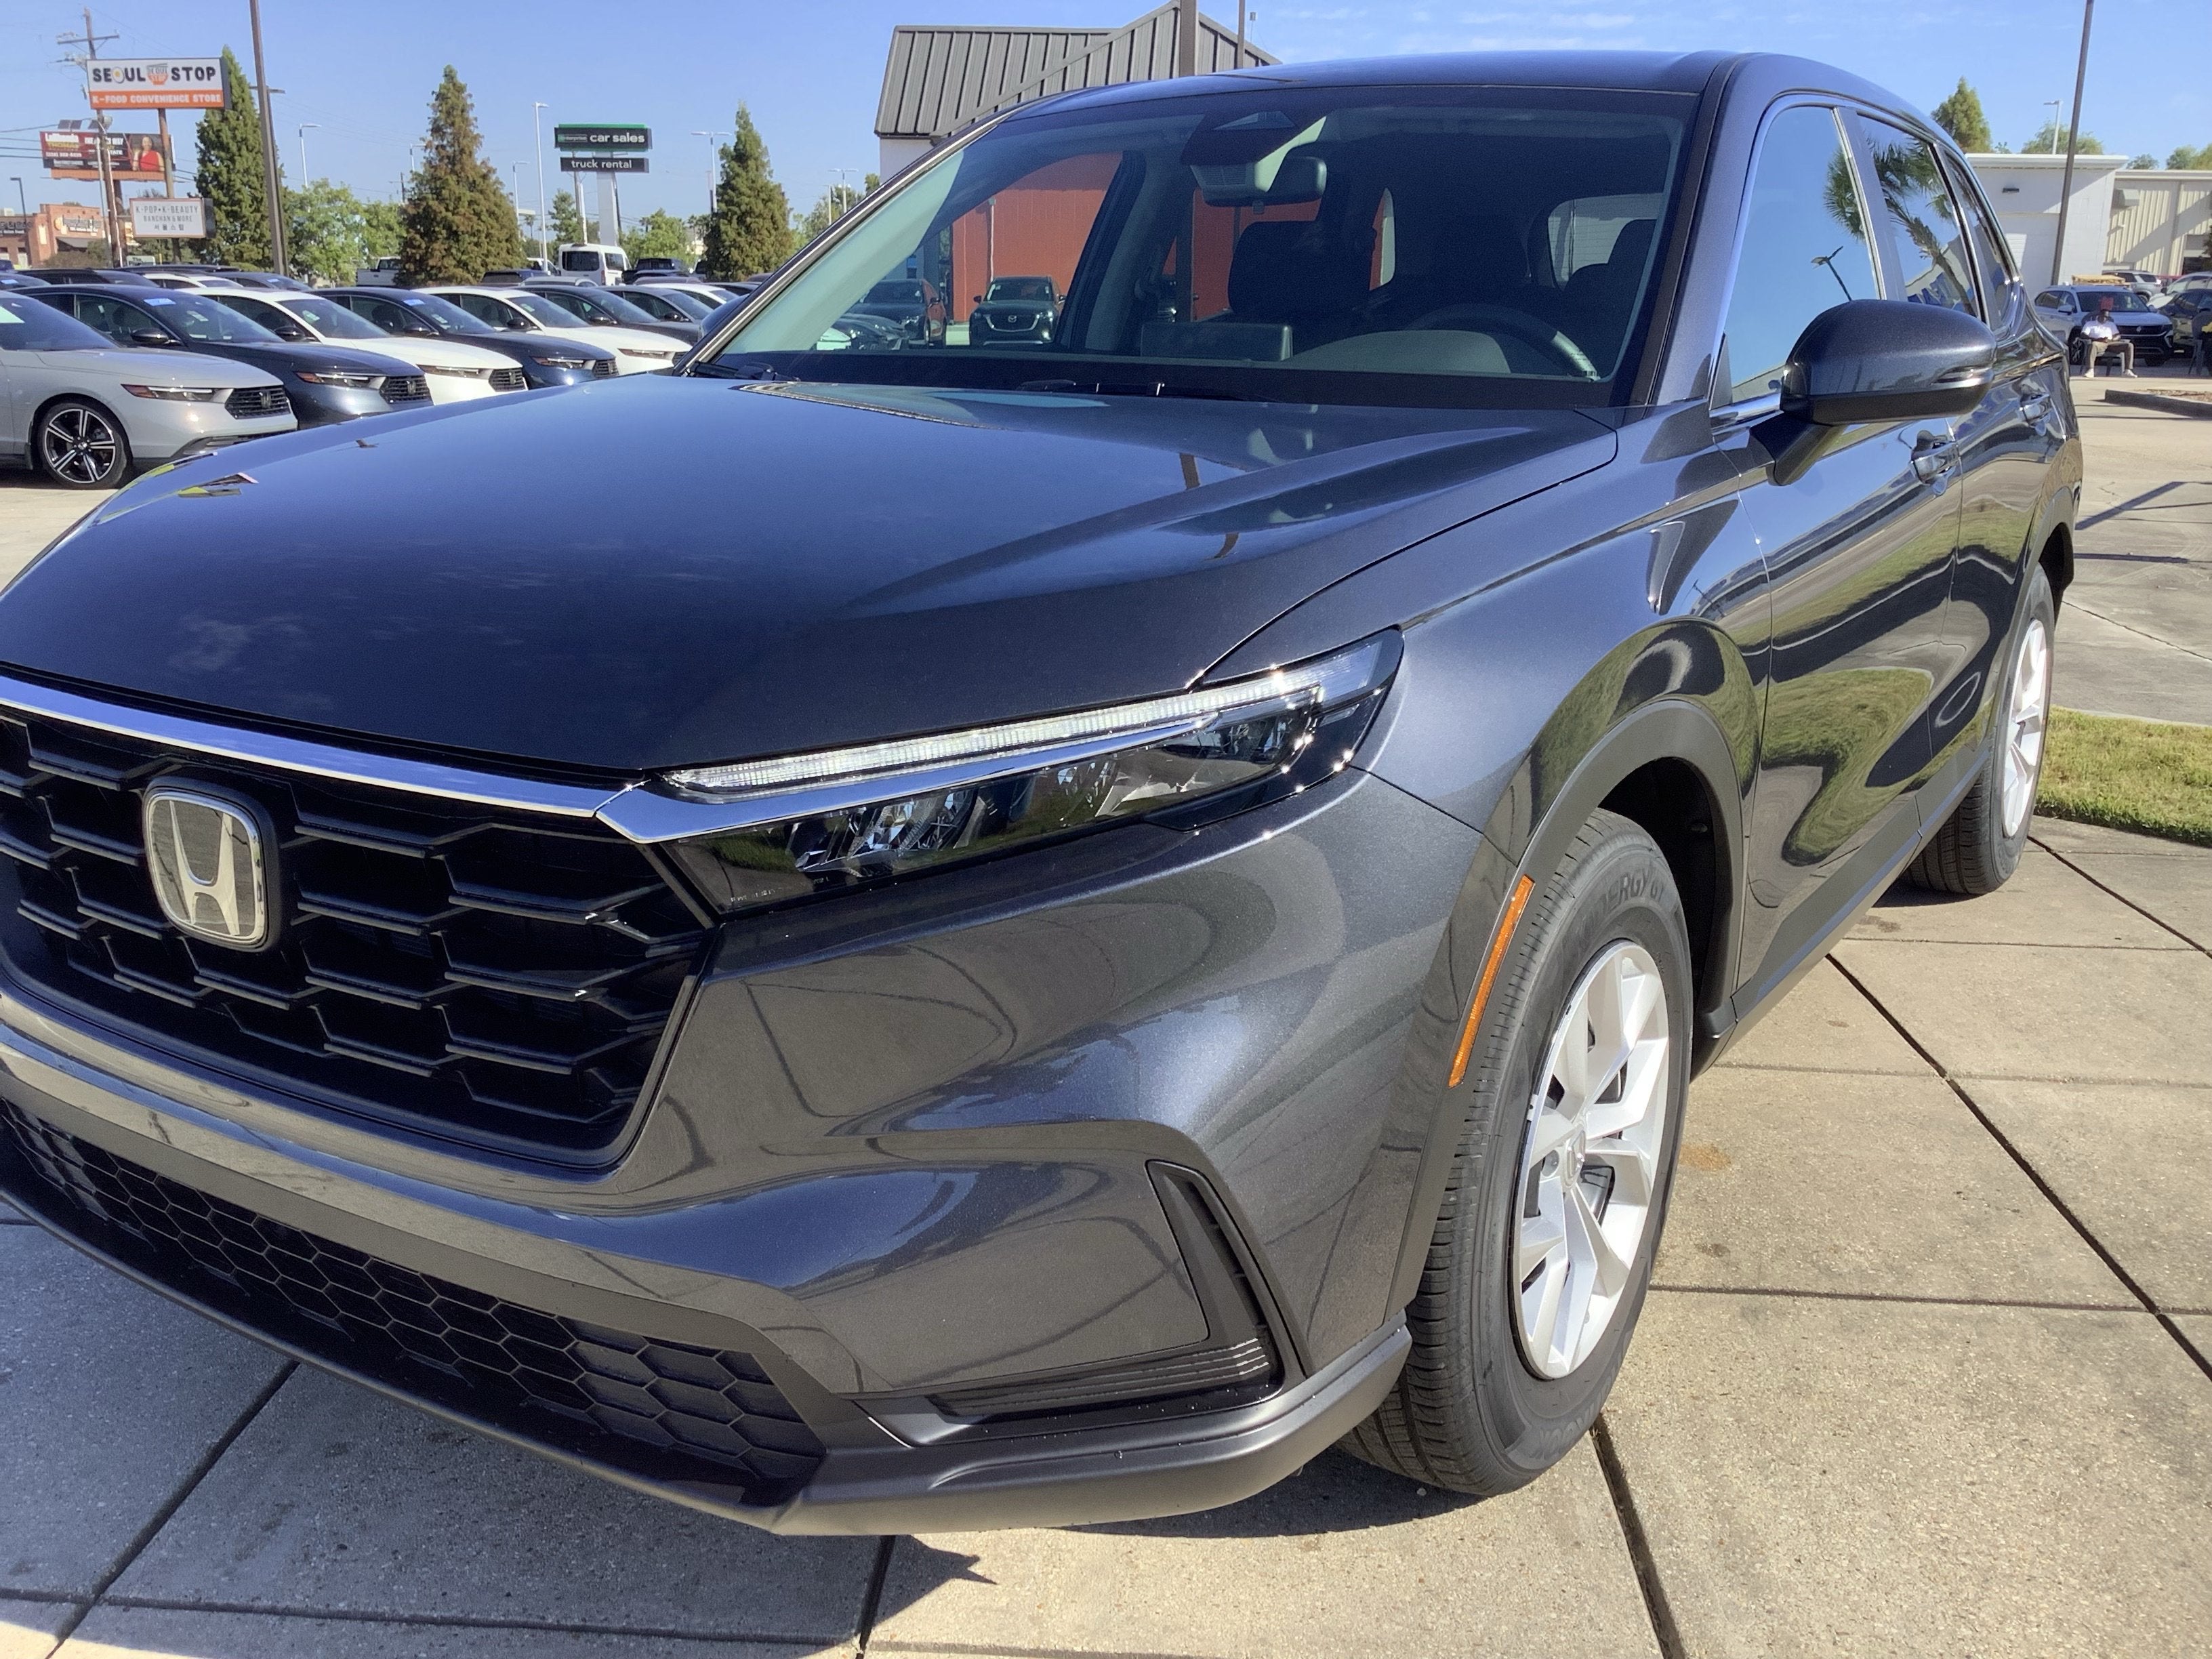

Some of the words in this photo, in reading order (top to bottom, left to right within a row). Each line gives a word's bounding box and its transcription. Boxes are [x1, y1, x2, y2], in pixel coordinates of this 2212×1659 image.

[92, 66, 146, 84] SEOUL
[171, 66, 216, 81] STOP
[92, 95, 127, 104] K-FOOD
[130, 94, 190, 104] CONVENIENCE
[192, 94, 222, 103] STORE
[590, 135, 610, 143] car
[613, 132, 644, 143] sales
[571, 159, 598, 169] truck
[601, 160, 632, 169] rental
